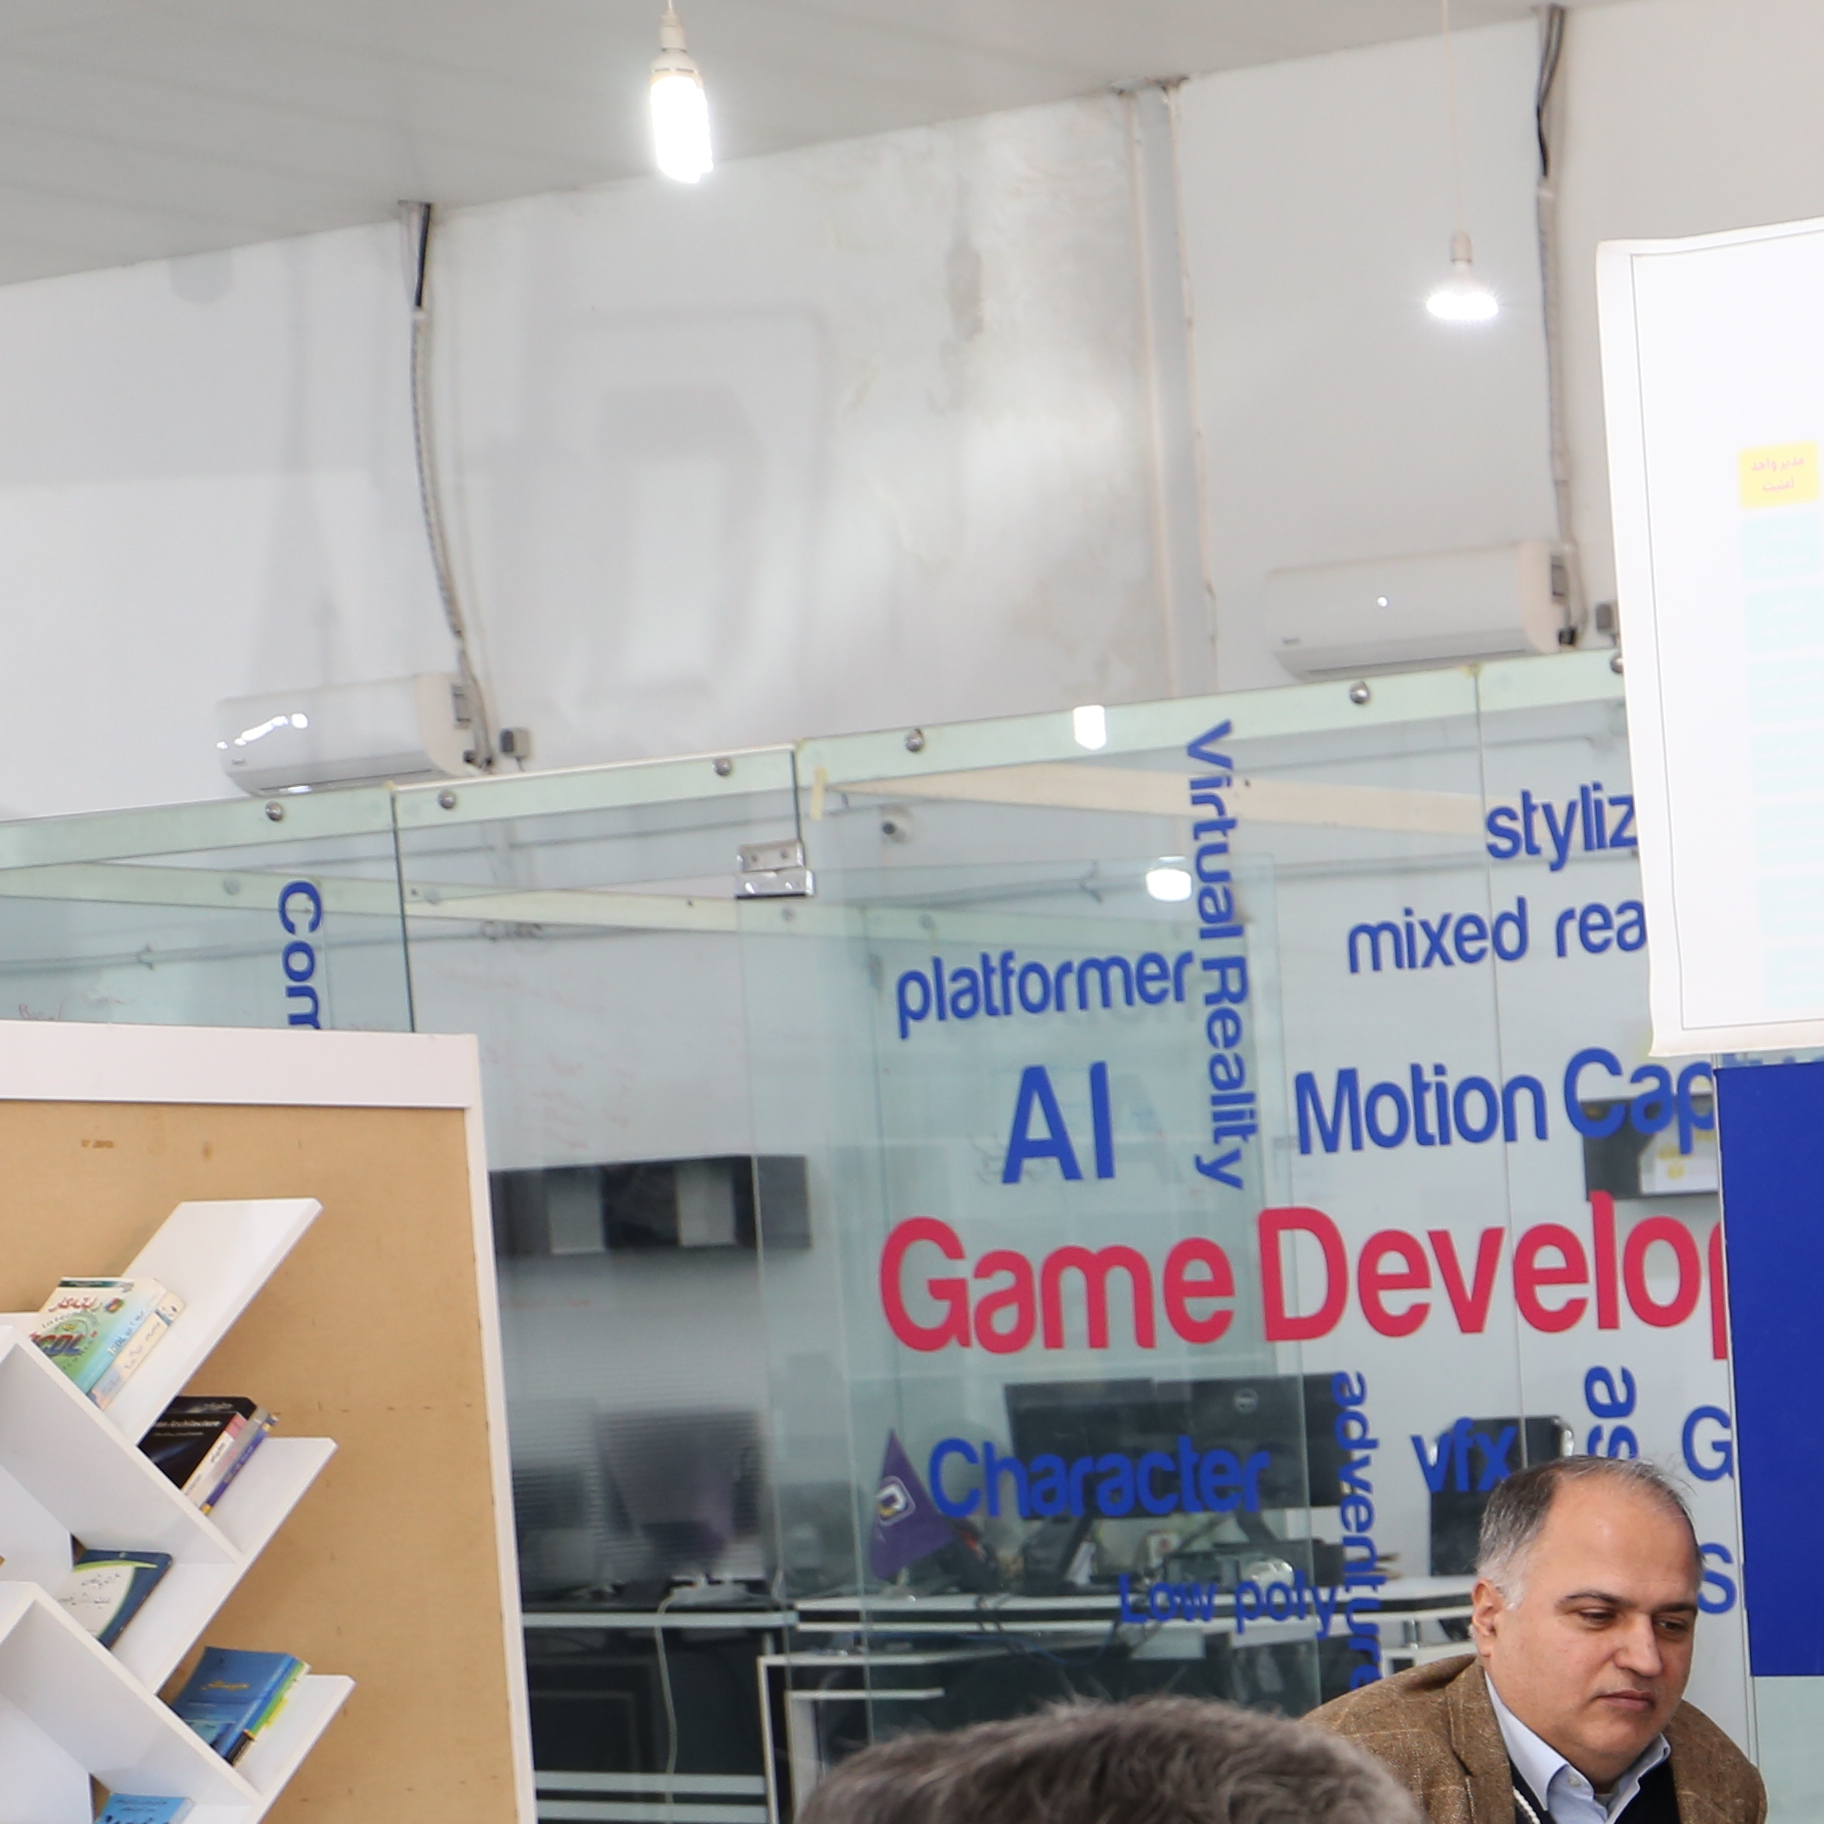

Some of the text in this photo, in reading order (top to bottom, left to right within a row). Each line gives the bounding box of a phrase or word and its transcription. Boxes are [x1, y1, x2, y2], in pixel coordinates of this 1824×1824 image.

[1188, 720, 1258, 1190] Virtual Reality
[1347, 896, 1529, 974] mixed
[896, 950, 1194, 1040] platformer
[1001, 1060, 1117, 1185] AI
[1294, 1063, 1548, 1156] Motion
[880, 1217, 1235, 1354] Game
[928, 1435, 1272, 1519] Character
[1410, 1416, 1517, 1494] vfx
[1118, 1568, 1338, 1641] Low poly
